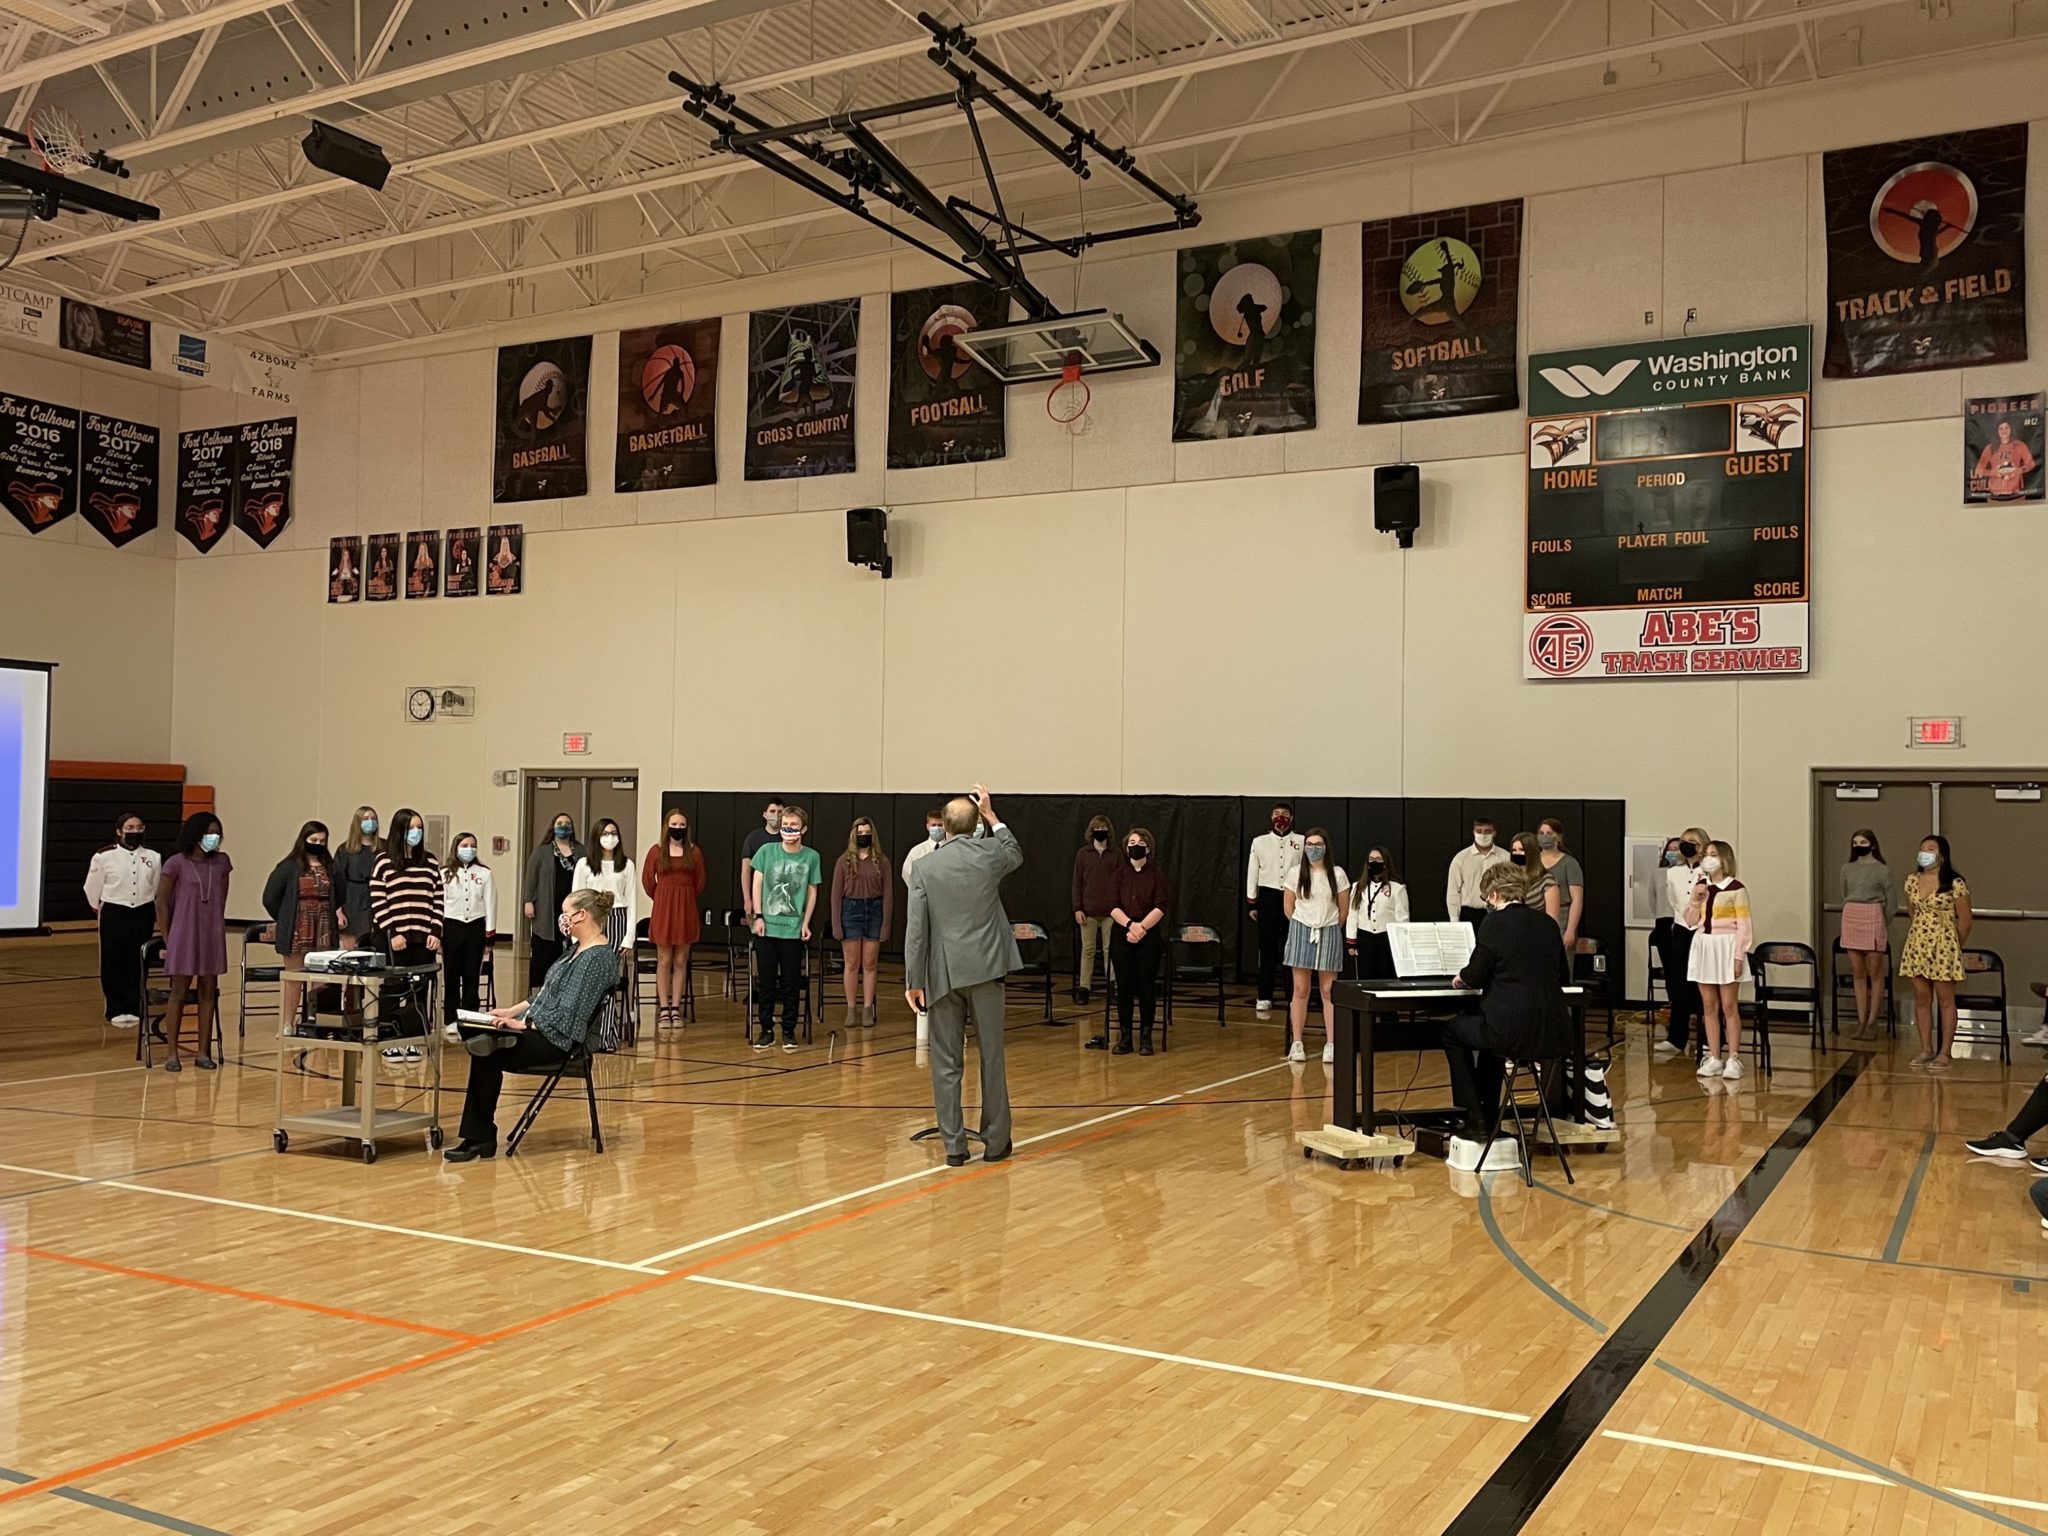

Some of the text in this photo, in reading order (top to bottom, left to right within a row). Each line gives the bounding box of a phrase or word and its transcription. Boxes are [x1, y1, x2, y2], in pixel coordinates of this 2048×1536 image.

[1836, 287, 1914, 322] TRACK
[1919, 286, 1939, 305] &
[1945, 268, 2012, 303] FIELD
[1391, 336, 1487, 371] SOFTBALL
[1648, 345, 1797, 376] Washington
[1219, 367, 1265, 396] GOLF
[1652, 368, 1791, 392] COUNTY BANK
[252, 387, 290, 403] FARMS
[0, 397, 76, 430] Fort Calhoun
[911, 393, 988, 426] FOOTBALL
[1970, 400, 2040, 415] PIONEER
[15, 422, 61, 443] 2016
[86, 415, 155, 444] Fort Calhoun
[629, 423, 707, 452] BASKETBALL
[757, 413, 849, 446] CROSS COUNTRY
[99, 434, 140, 454] 2017
[192, 446, 224, 461] 2017
[250, 438, 282, 454] 2018
[512, 444, 570, 469] BASEBALL
[1725, 453, 1792, 476] GUEST
[1543, 469, 1598, 490] HOME
[1637, 472, 1685, 488] PERIOD
[1618, 531, 1709, 549] PLAYER FOUL
[1753, 525, 1799, 541] FOULS
[1532, 539, 1572, 553] FOULS
[1531, 592, 1572, 606] SCORE
[1637, 587, 1683, 601] MATCH
[1753, 582, 1800, 597] SCORE
[1640, 607, 1760, 647] ABE'S
[1602, 647, 1802, 675] TRASH SERVICE
